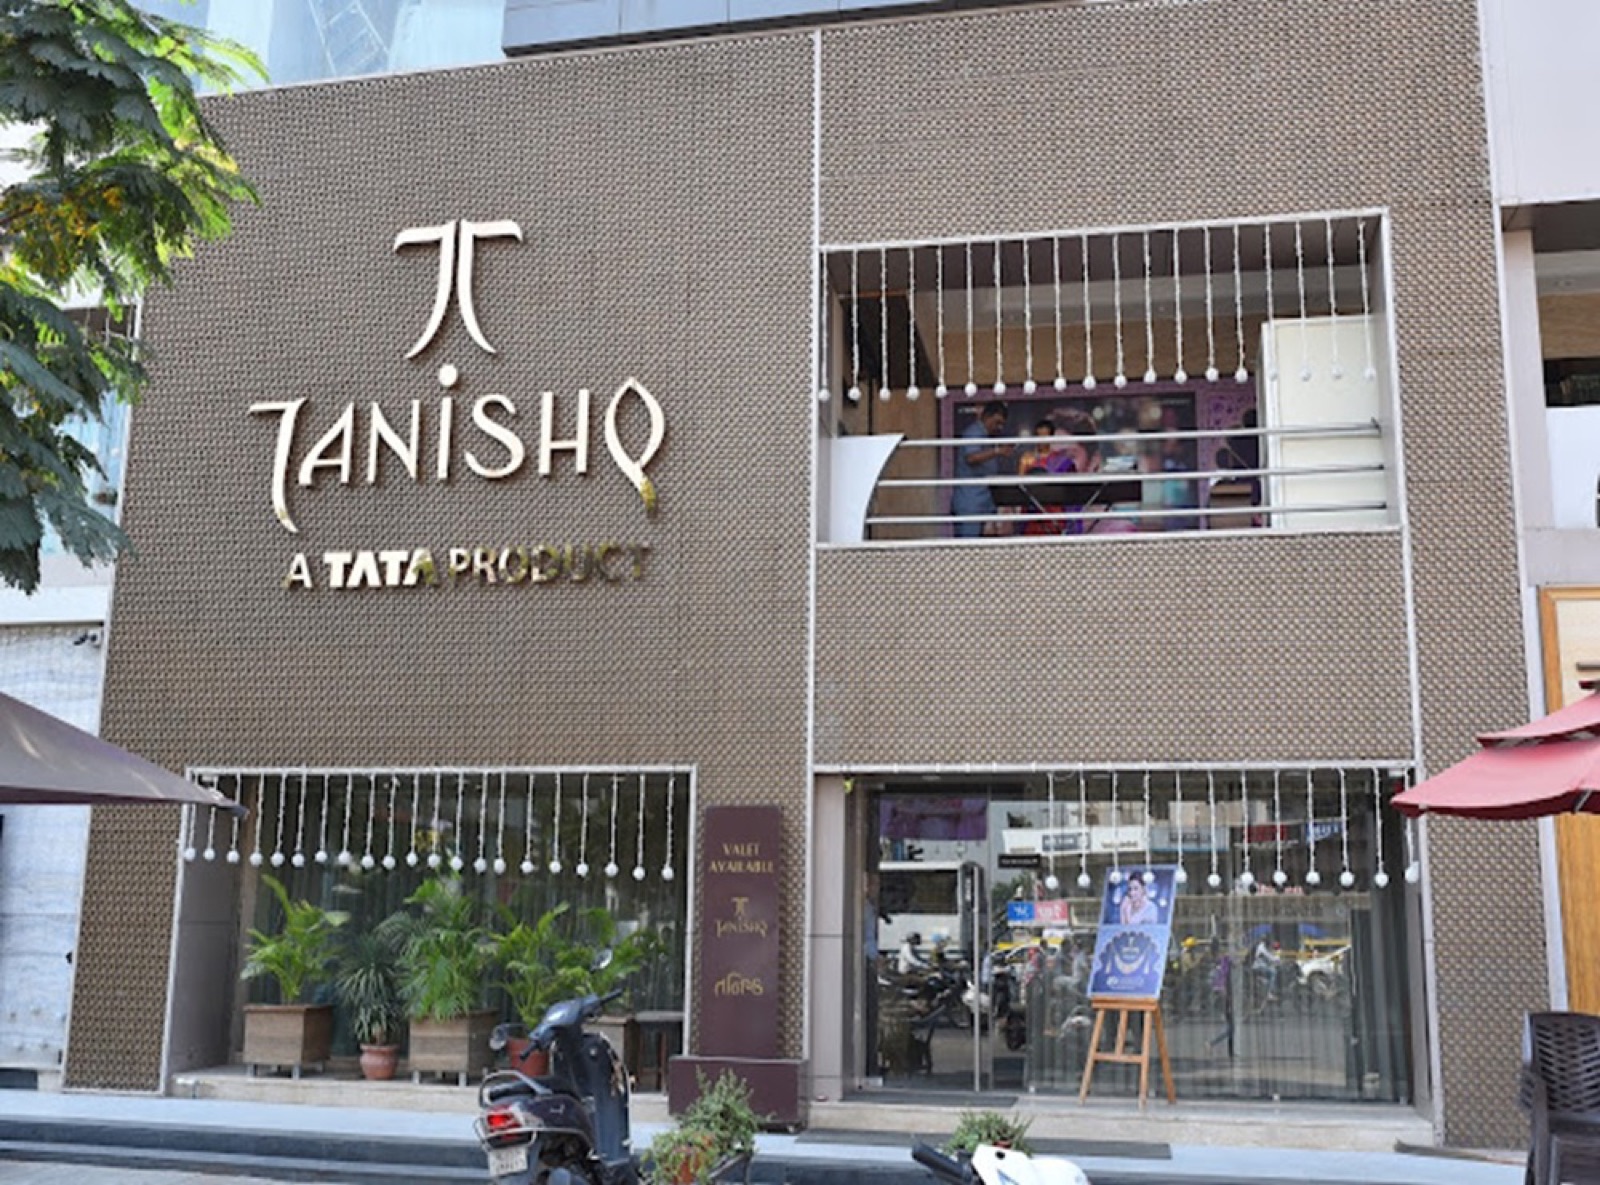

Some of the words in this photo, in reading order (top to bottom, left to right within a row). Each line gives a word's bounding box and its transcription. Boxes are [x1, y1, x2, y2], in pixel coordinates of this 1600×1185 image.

[284, 552, 313, 590] A
[323, 550, 441, 589] TATA
[449, 543, 651, 586] PRODUCT
